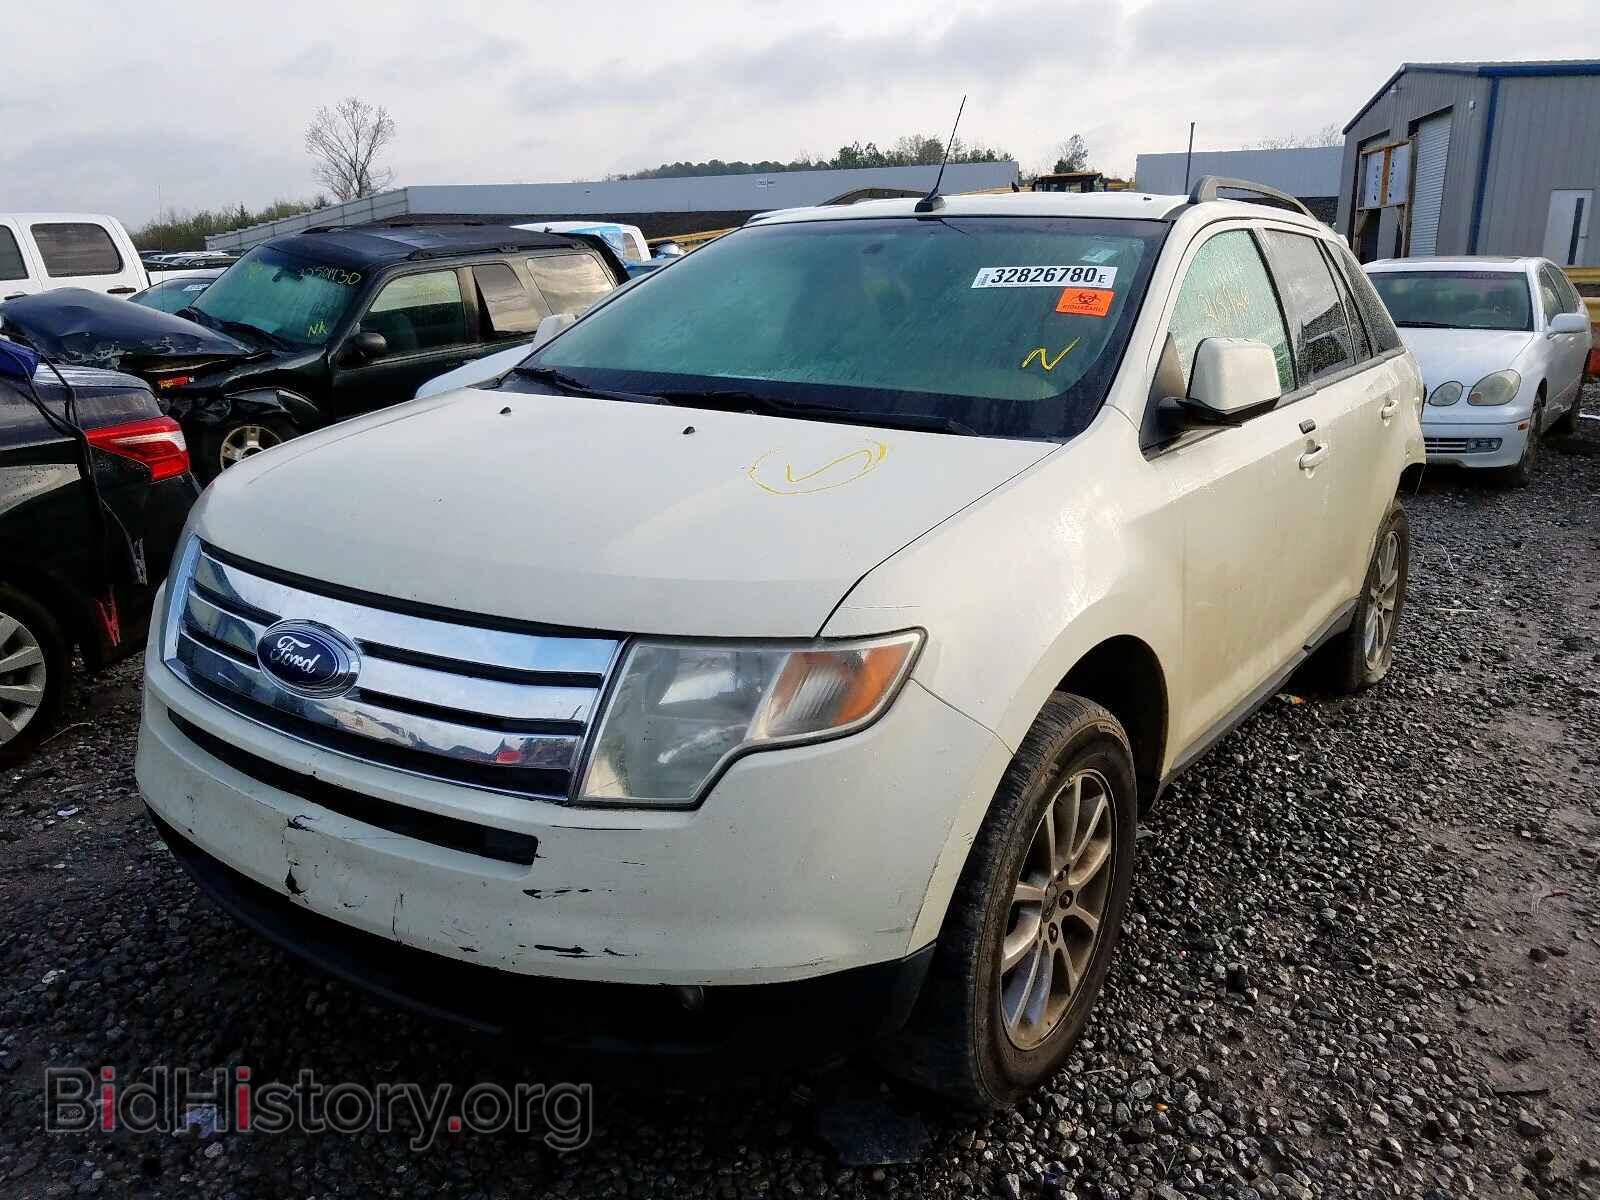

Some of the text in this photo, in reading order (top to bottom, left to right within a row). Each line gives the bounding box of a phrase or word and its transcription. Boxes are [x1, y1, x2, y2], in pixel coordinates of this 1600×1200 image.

[991, 267, 1097, 283] 32826780
[1098, 274, 1107, 283] E
[270, 635, 321, 674] Ford
